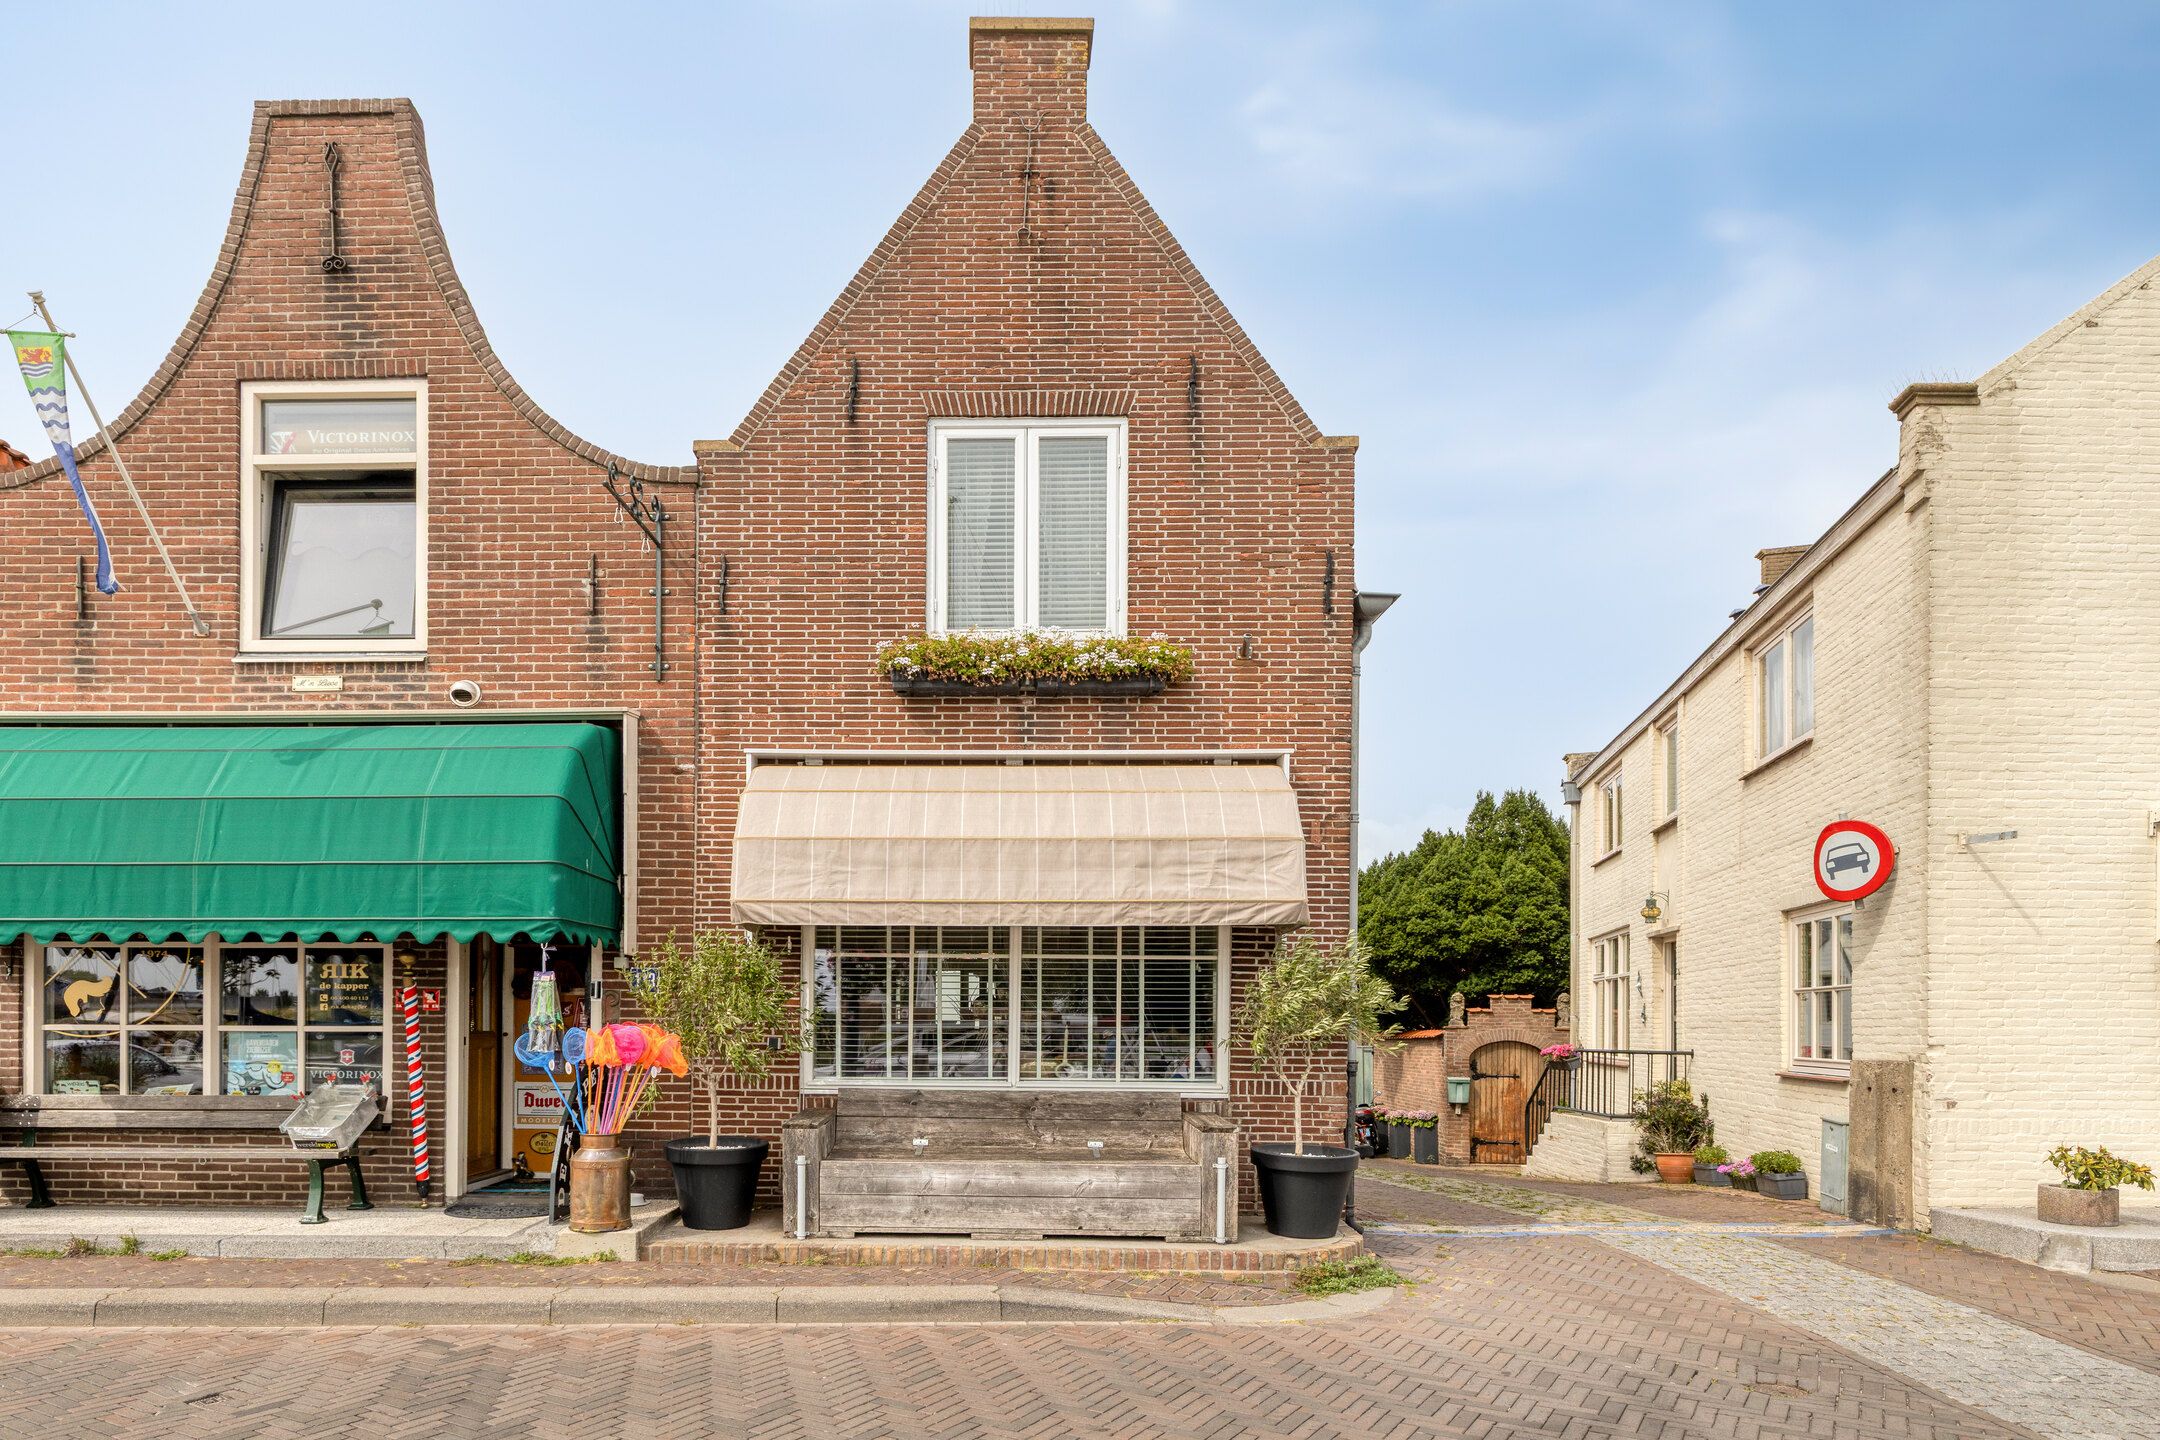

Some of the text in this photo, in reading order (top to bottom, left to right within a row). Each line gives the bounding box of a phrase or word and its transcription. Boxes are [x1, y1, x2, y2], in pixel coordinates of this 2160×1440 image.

[306, 429, 415, 444] VICTORINOX
[141, 950, 168, 958] 1974
[334, 982, 369, 991] kapper
